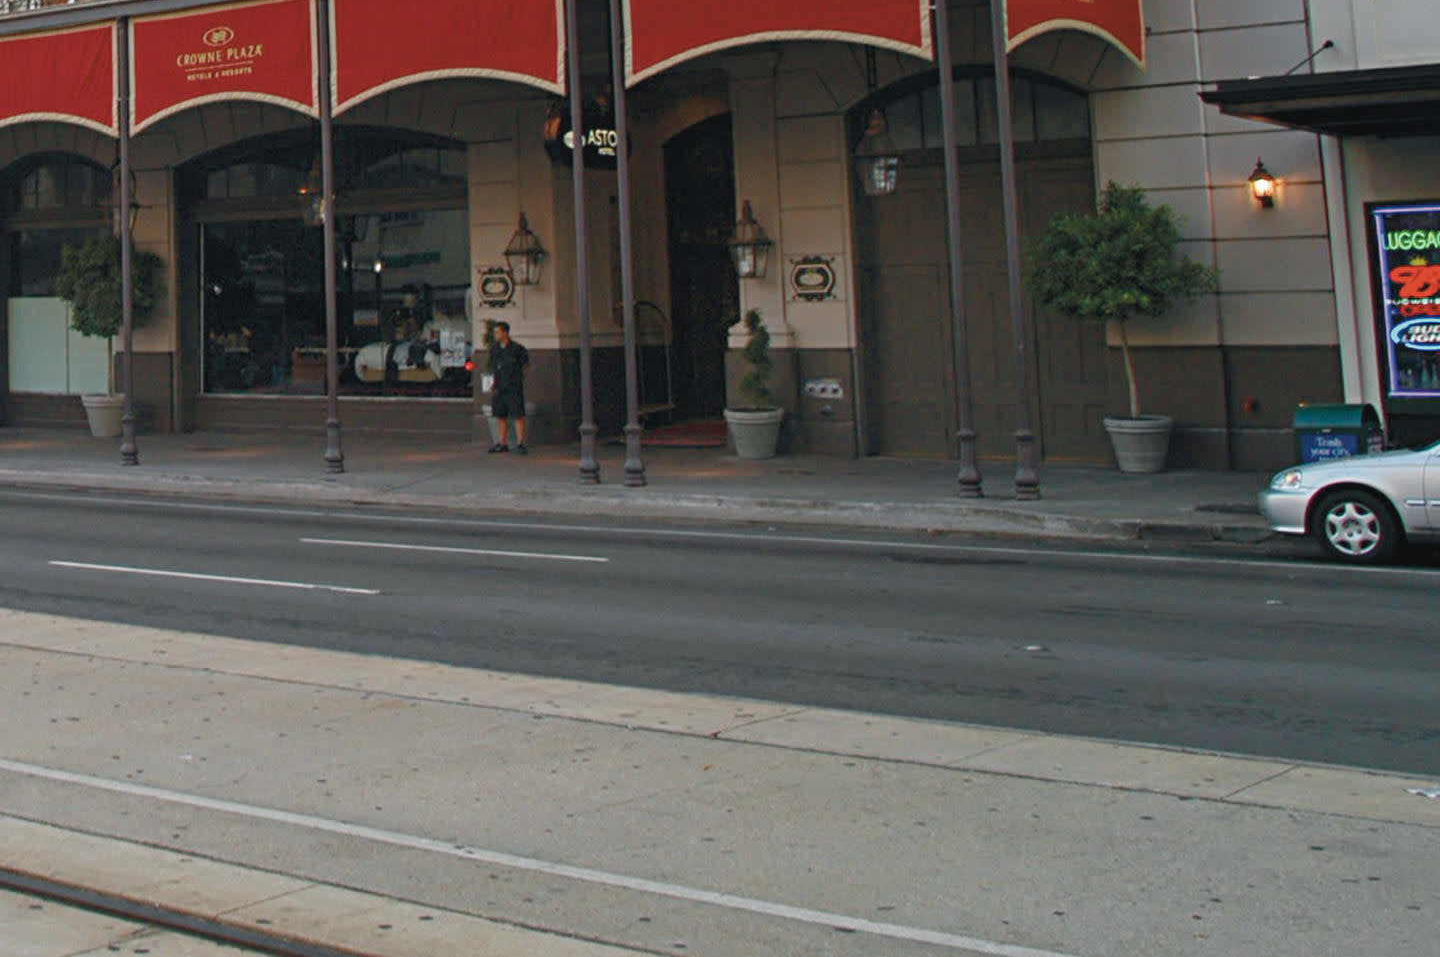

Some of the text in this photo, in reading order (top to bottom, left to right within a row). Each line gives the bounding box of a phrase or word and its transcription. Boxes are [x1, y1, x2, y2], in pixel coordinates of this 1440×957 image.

[176, 44, 263, 67] CROWNE PLAZA
[587, 129, 618, 148] ASTO
